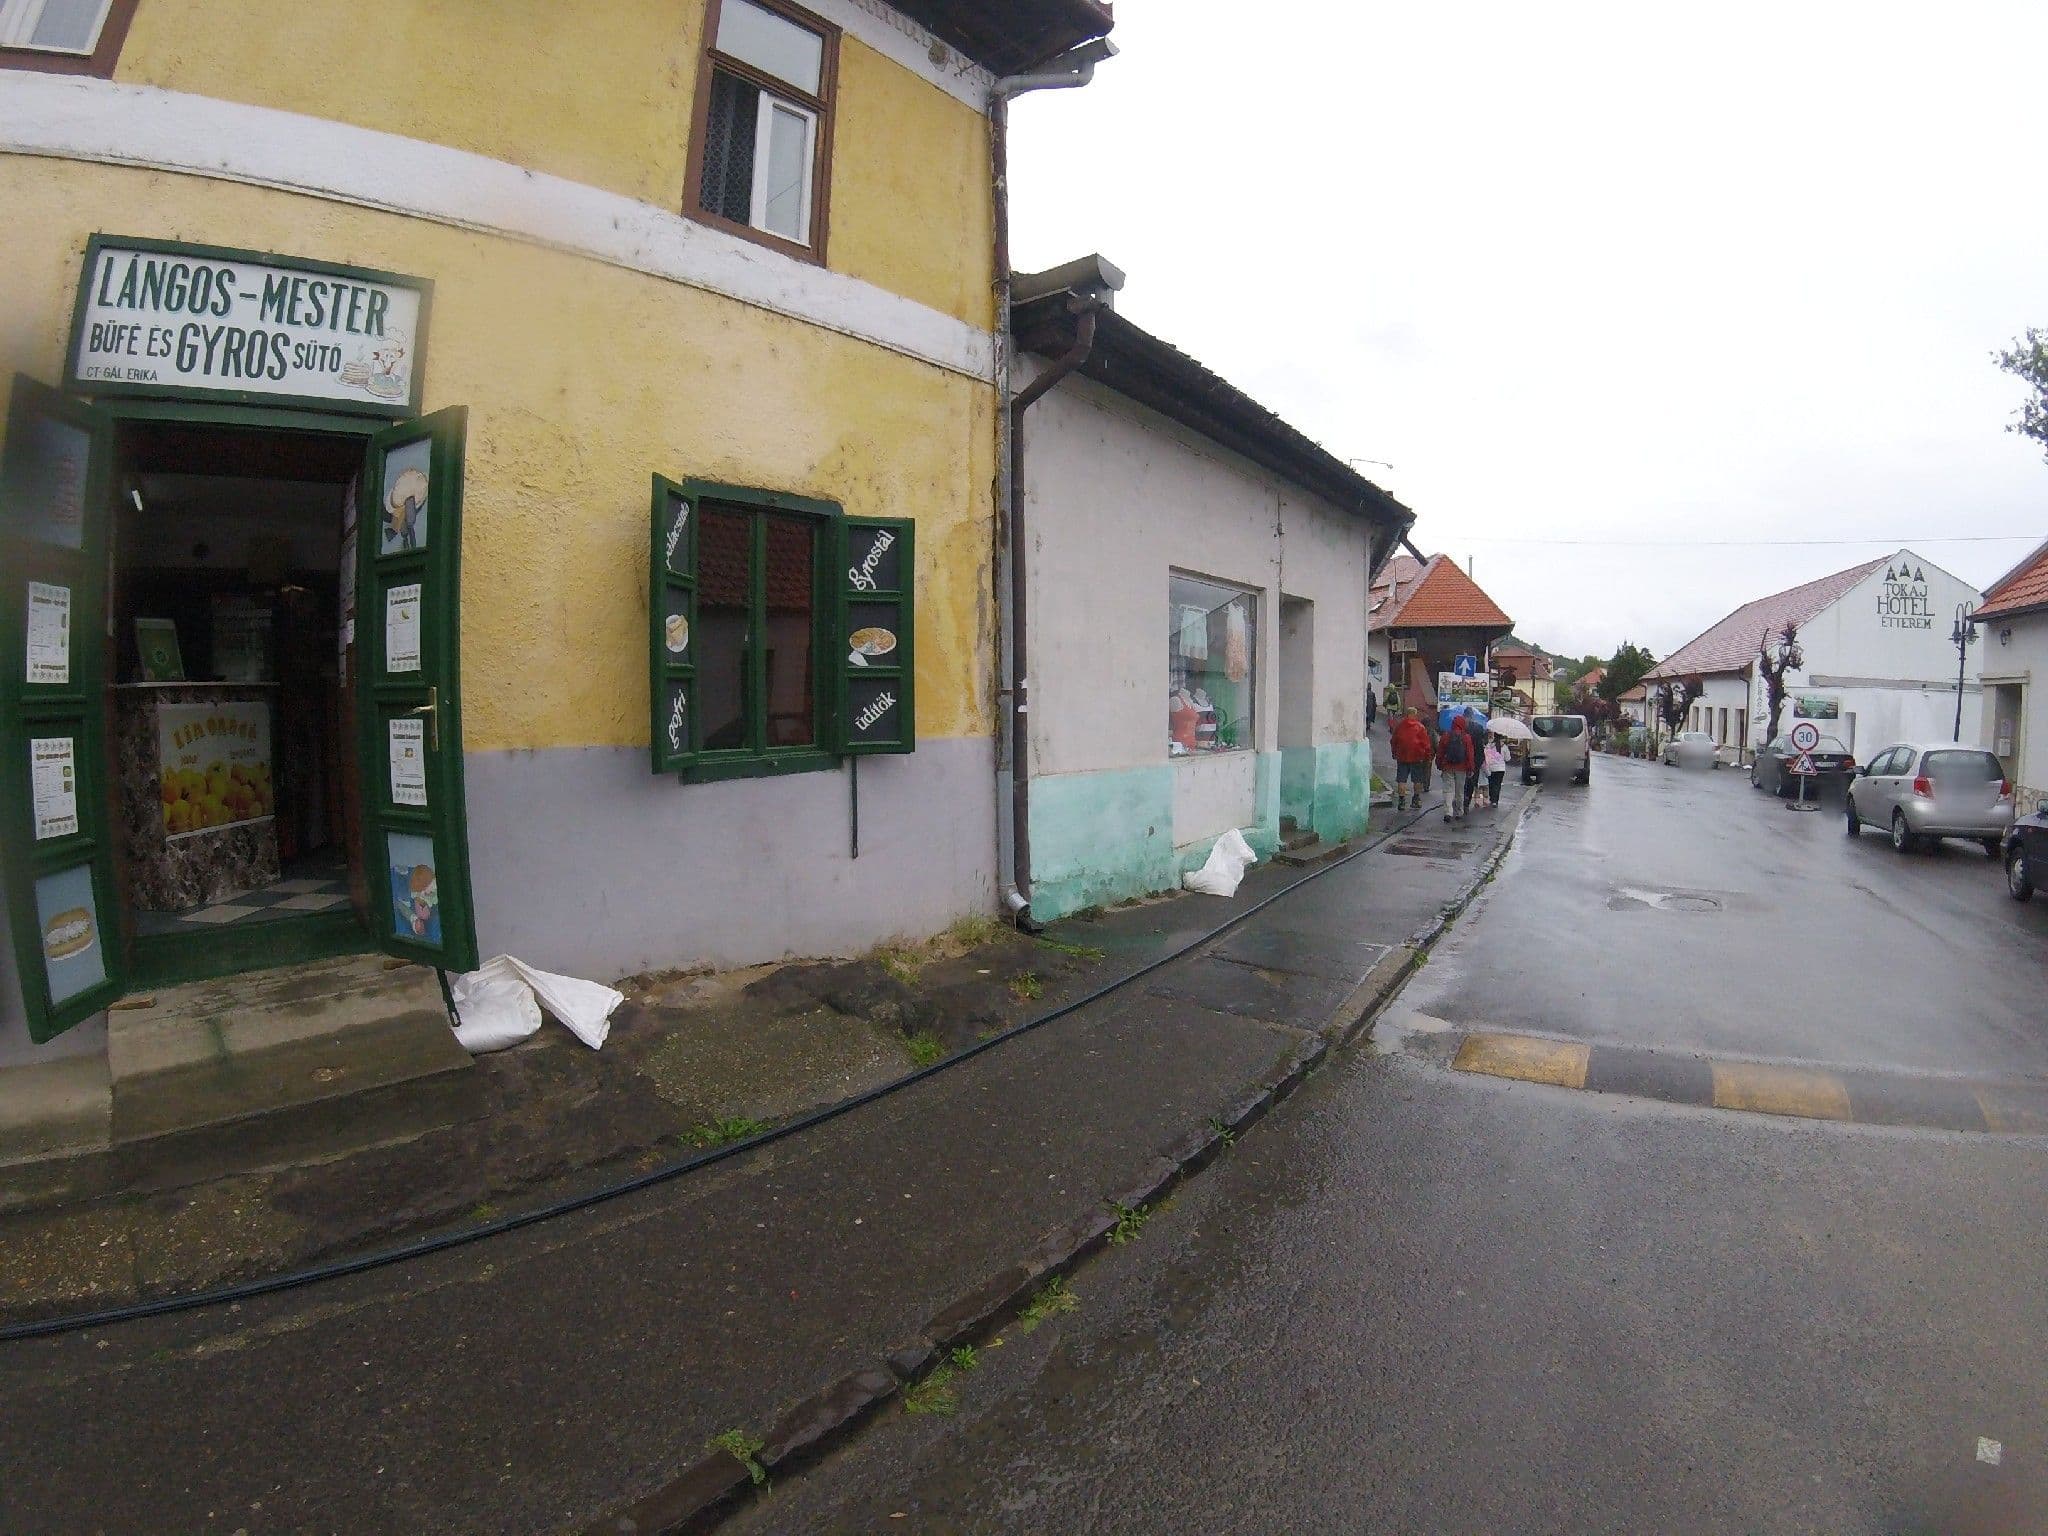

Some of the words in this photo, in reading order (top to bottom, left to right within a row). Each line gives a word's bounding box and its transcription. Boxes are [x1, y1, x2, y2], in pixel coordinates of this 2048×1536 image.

[90, 319, 142, 355] BÜFÉ
[146, 324, 174, 357] ÉS
[176, 322, 290, 380] GYROS
[127, 367, 157, 380] ERIKA
[848, 529, 896, 591] gyrostál
[1883, 582, 1928, 597] TOKAJ
[1876, 595, 1936, 617] HOTEL
[1799, 731, 1813, 743] 30
